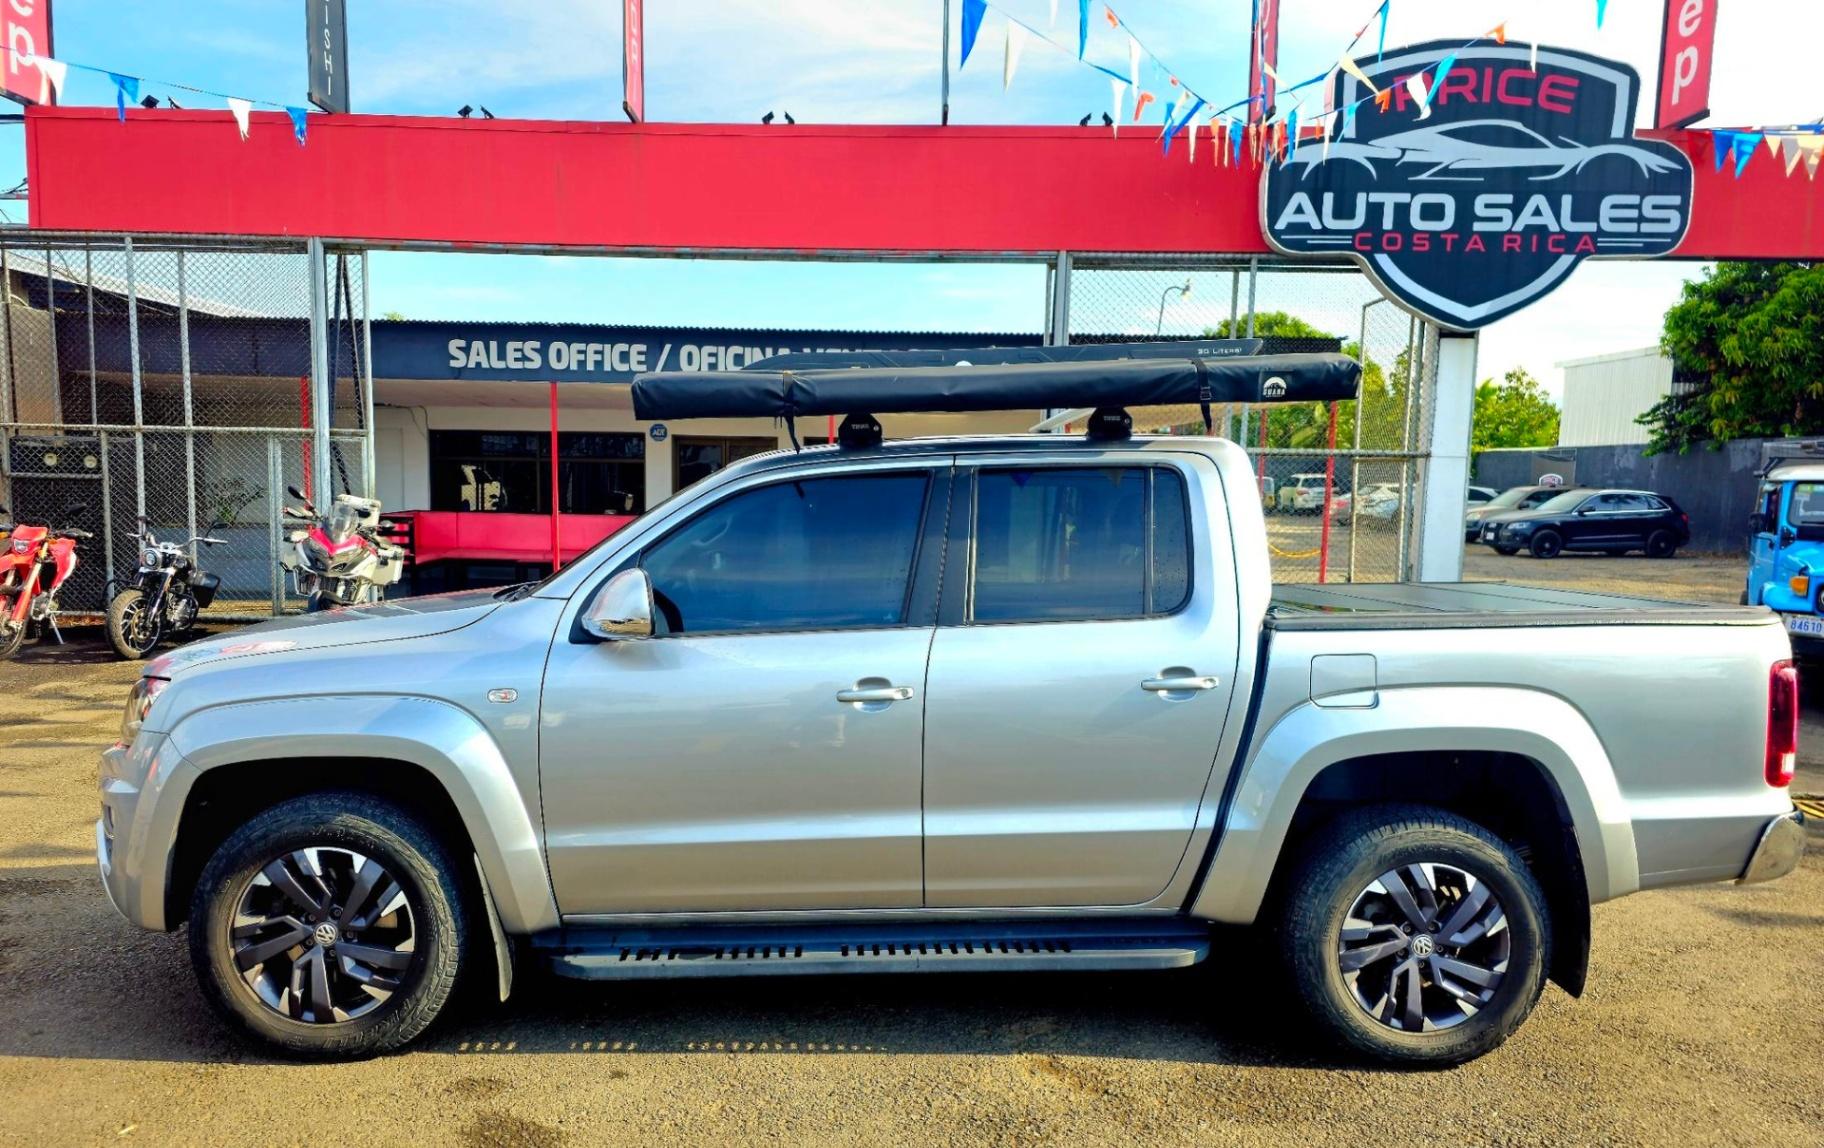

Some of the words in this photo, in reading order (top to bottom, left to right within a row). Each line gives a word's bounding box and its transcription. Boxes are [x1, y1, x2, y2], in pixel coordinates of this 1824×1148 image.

[1393, 67, 1580, 114] PRICE
[1274, 192, 1456, 230] AUTO
[1472, 194, 1682, 232] SALES
[1354, 232, 1486, 252] COSTA
[1502, 233, 1596, 252] RICA
[448, 339, 542, 369] SALES
[548, 341, 647, 372] OFFICE
[654, 343, 672, 373] /
